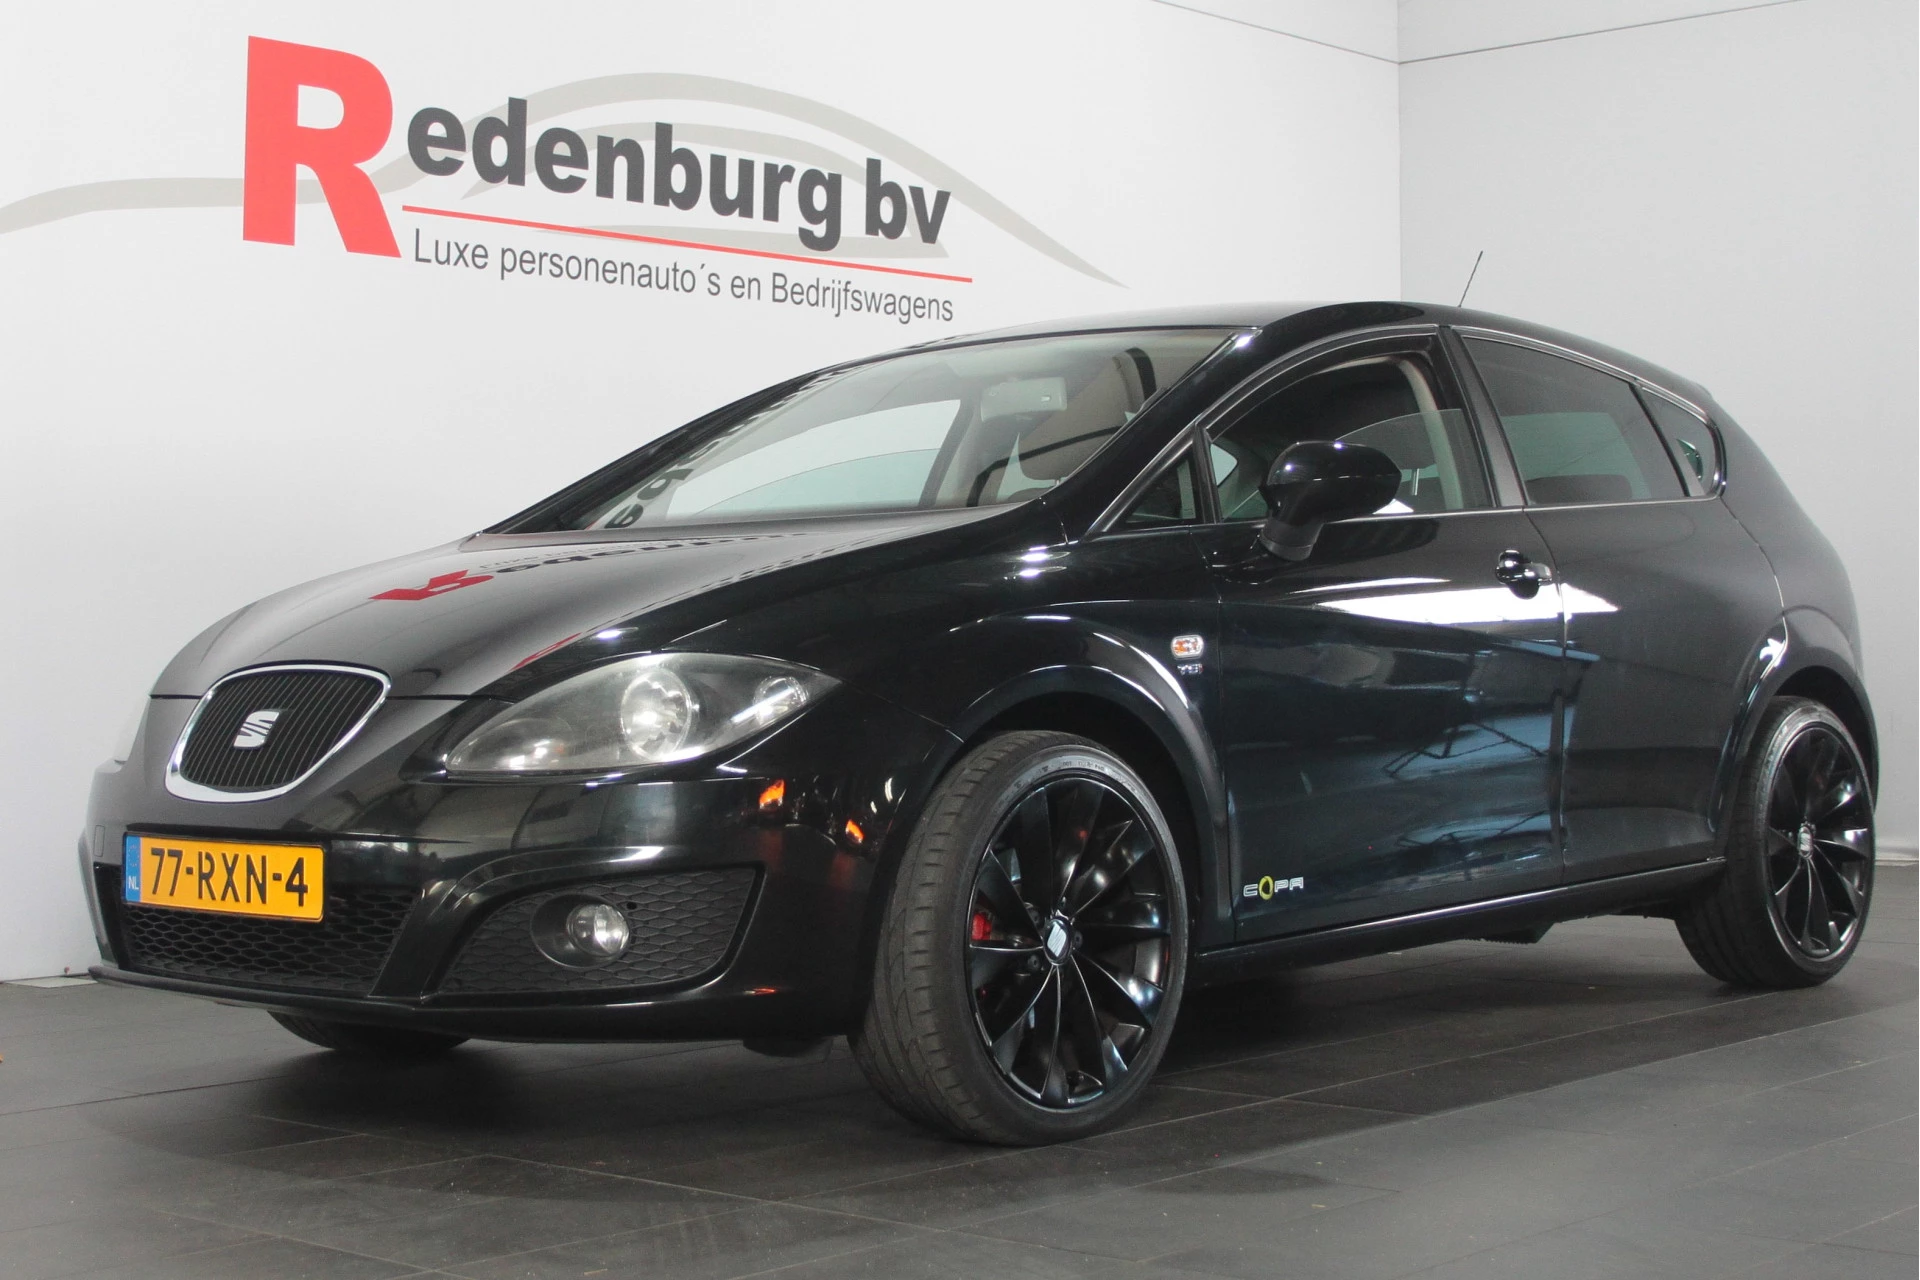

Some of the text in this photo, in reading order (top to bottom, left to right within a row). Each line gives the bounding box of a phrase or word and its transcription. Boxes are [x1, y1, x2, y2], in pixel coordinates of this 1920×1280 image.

[244, 36, 951, 257] Redenburg bv
[415, 228, 489, 270] Luxe
[730, 275, 761, 301] en
[772, 272, 954, 325] Bedrijfswagens
[127, 874, 140, 891] NL
[151, 847, 310, 908] 77-RXN-4
[1243, 875, 1304, 900] COPA
